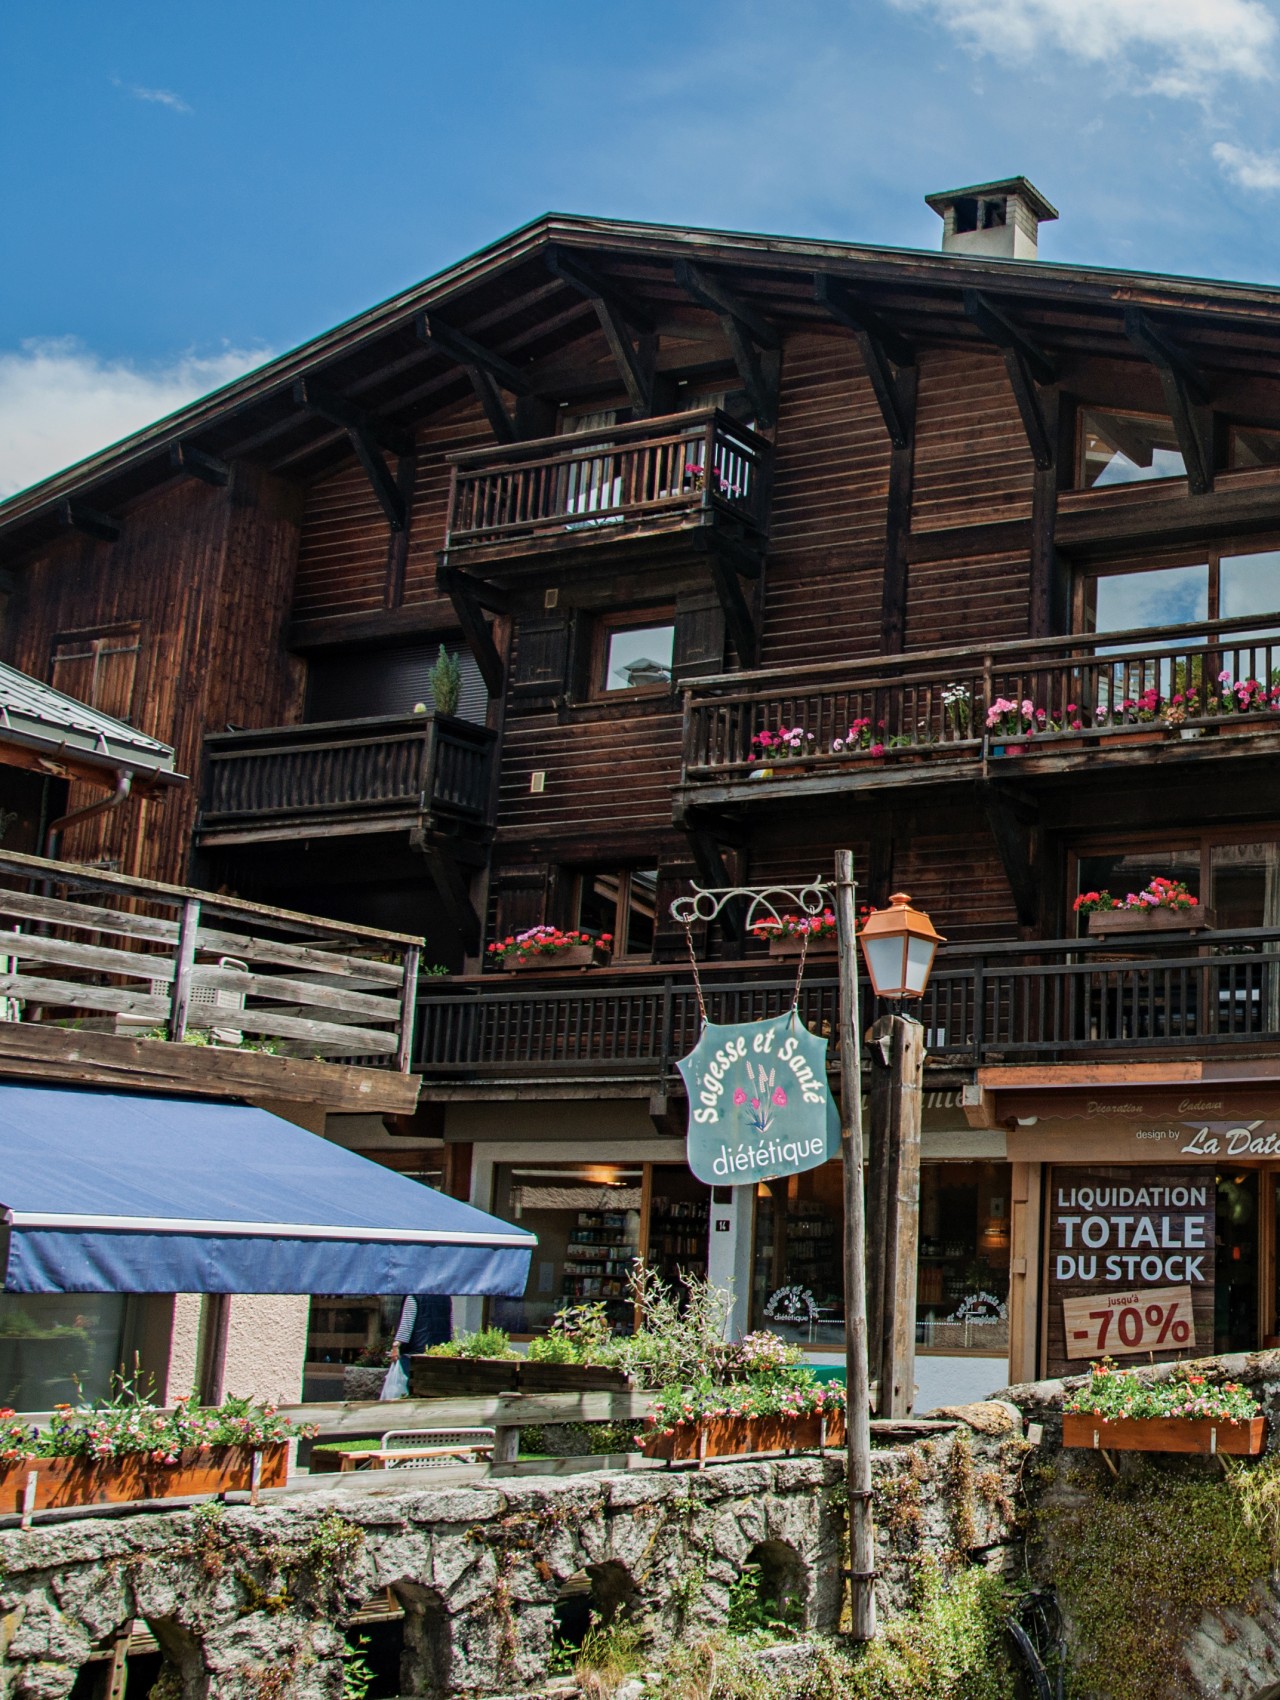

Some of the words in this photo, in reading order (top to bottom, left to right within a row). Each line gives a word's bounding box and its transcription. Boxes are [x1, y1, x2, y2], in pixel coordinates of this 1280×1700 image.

[694, 1036, 747, 1124] Sagesse
[753, 1028, 775, 1053] et
[778, 1037, 825, 1104] Santé
[1087, 1101, 1143, 1113] Décoration
[1178, 1098, 1222, 1113] Cadeaux
[1136, 1129, 1167, 1141] design
[1169, 1129, 1180, 1141] by
[1181, 1126, 1220, 1154] La
[713, 1137, 823, 1176] diététique
[1058, 1186, 1207, 1211] LIQUIDATION
[1058, 1215, 1206, 1249] TOTALE
[1056, 1256, 1097, 1281] DU
[1105, 1255, 1205, 1282] STOCK
[1107, 1293, 1140, 1308] jusqu'à
[774, 1313, 809, 1322] diététique
[1073, 1302, 1190, 1350] -70%
